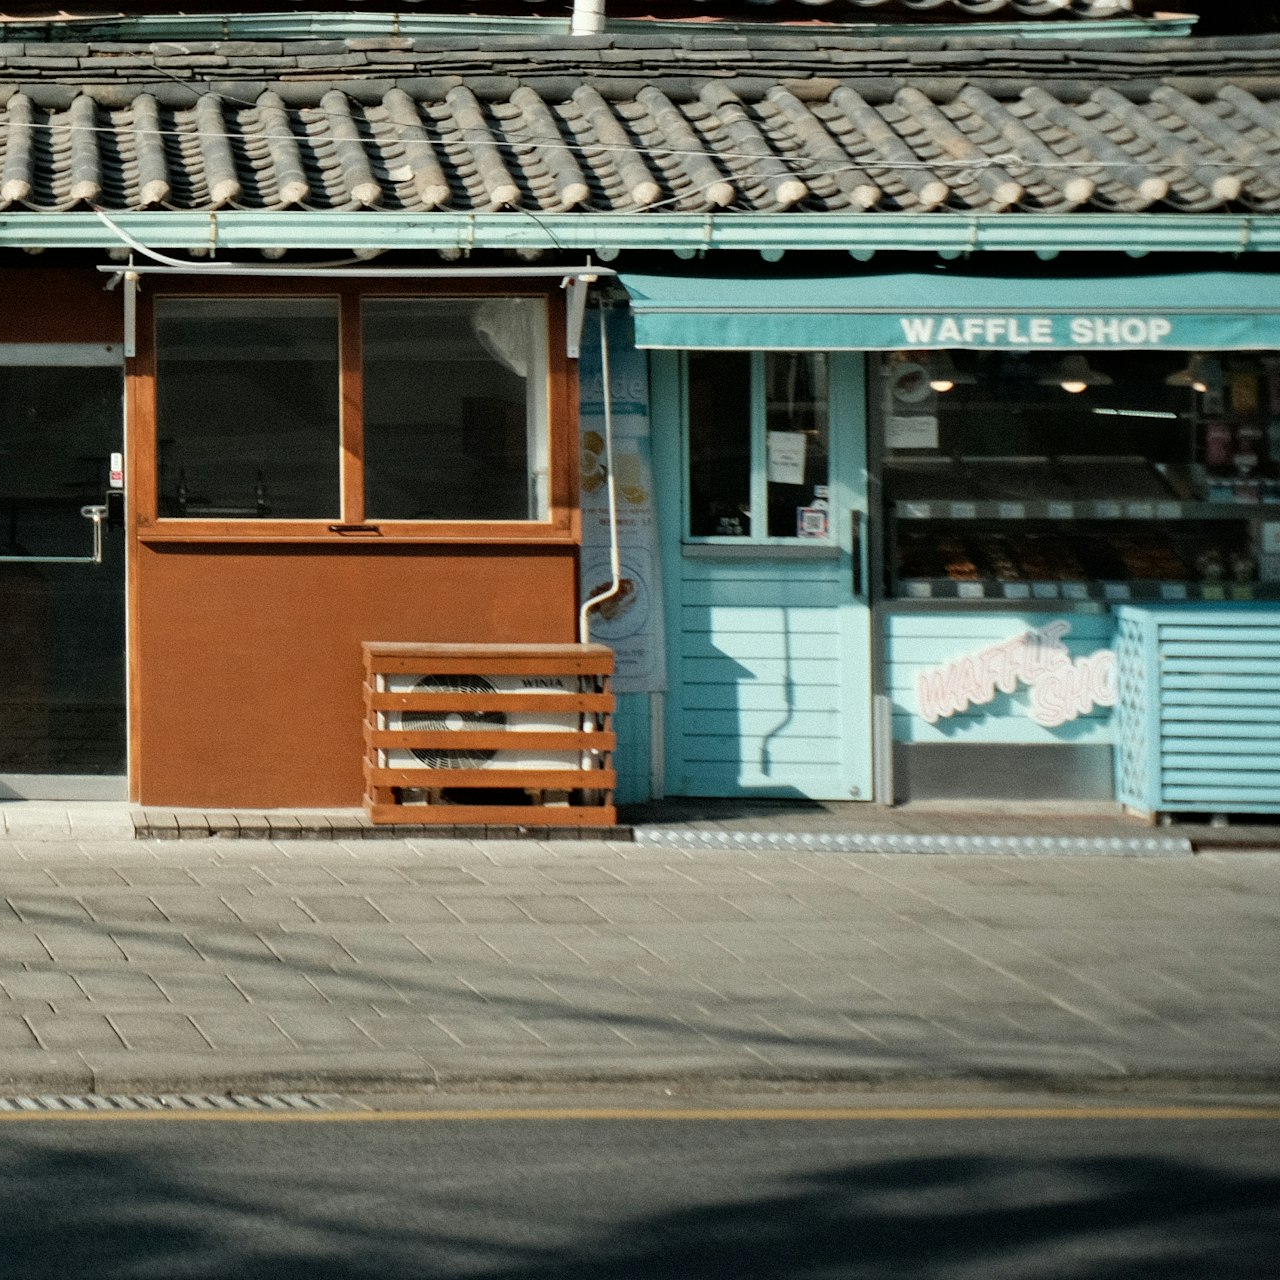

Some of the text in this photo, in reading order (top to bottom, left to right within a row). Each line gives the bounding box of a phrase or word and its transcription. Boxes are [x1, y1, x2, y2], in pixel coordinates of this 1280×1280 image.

[899, 318, 1172, 344] WAFFLE SHOP
[522, 679, 564, 688] WINIA
